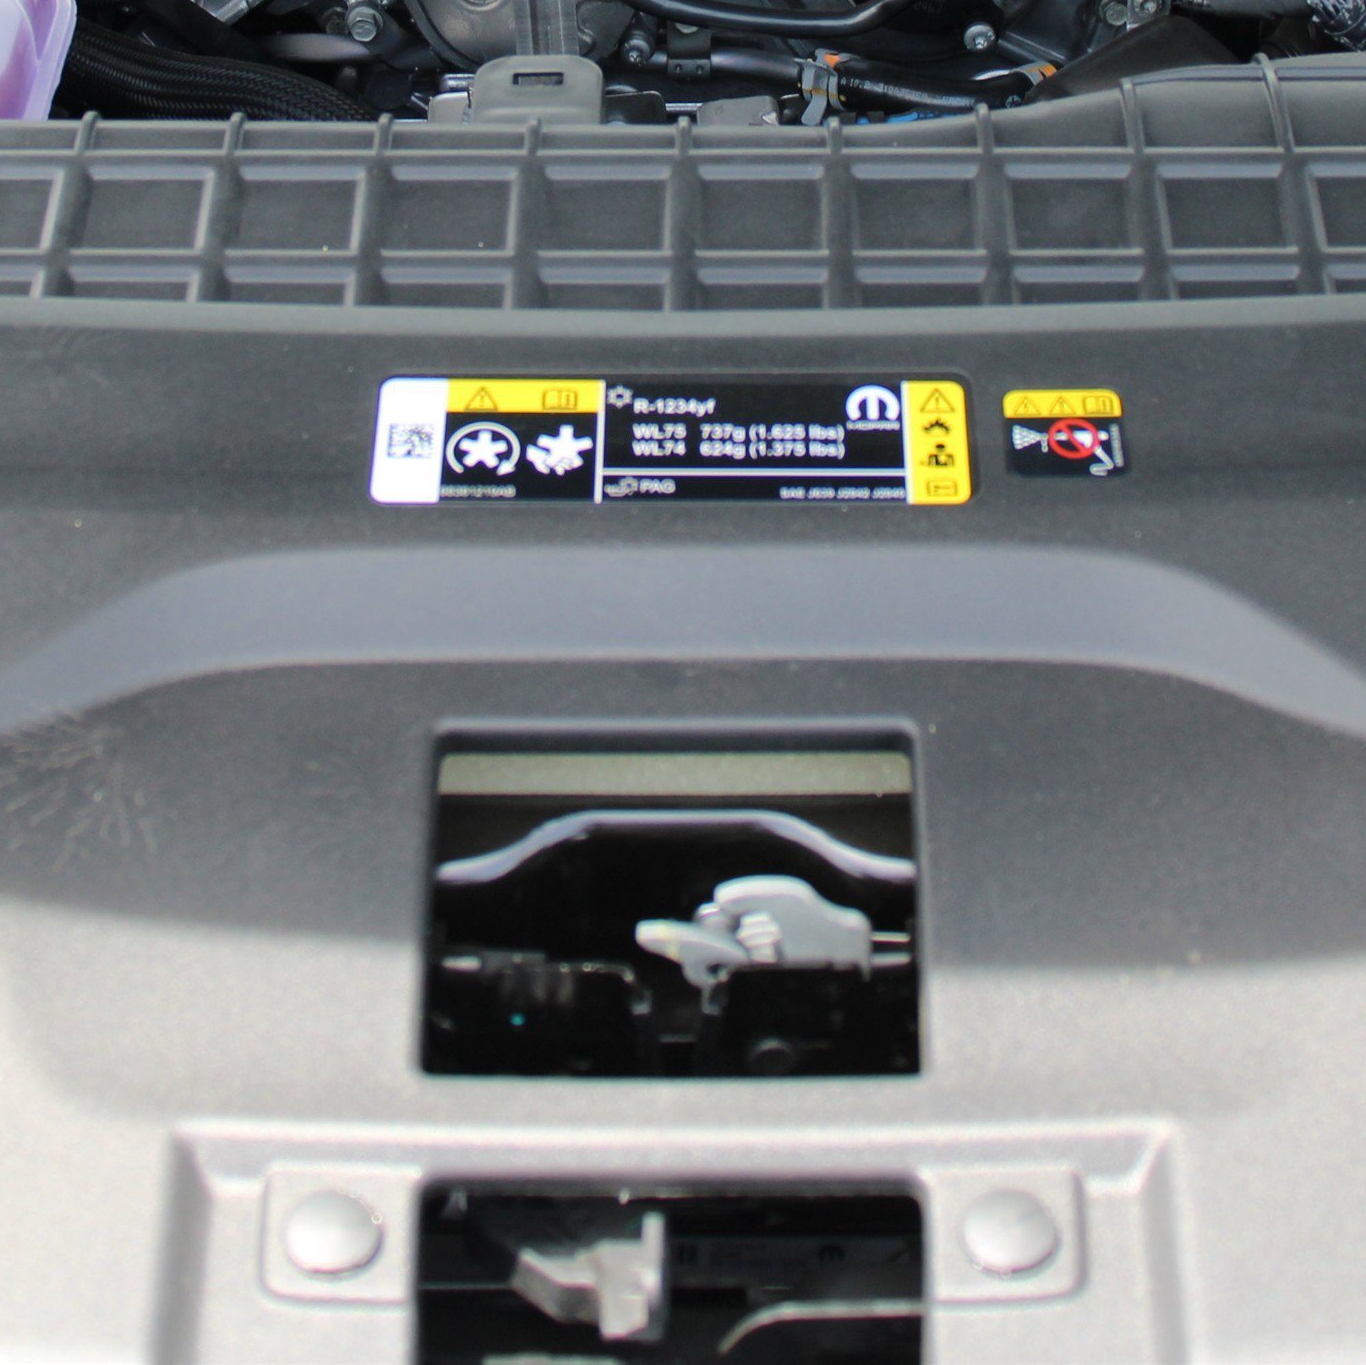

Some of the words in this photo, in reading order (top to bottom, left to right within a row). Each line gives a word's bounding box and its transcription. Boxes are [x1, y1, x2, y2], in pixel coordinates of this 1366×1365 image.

[633, 398, 717, 417] R-1234yf
[632, 423, 687, 440] WL75
[700, 424, 746, 442] 737g
[749, 424, 806, 442] (1.625
[809, 424, 845, 442] lbs)
[632, 440, 687, 456] WL74
[699, 441, 746, 459] 624g
[809, 441, 845, 459] lbs)
